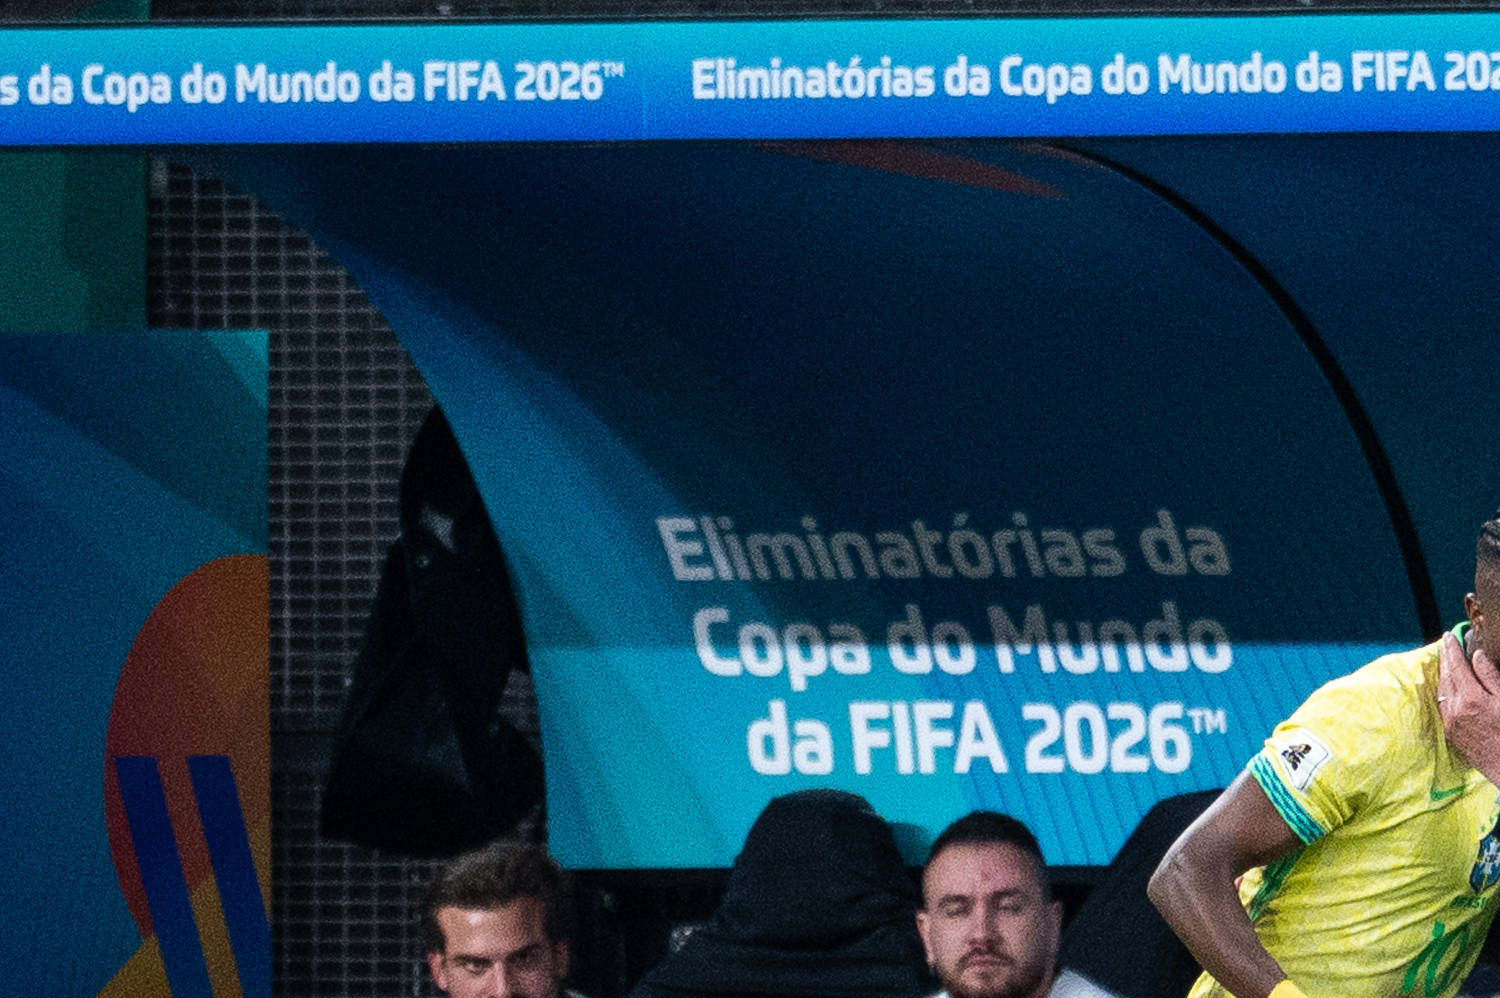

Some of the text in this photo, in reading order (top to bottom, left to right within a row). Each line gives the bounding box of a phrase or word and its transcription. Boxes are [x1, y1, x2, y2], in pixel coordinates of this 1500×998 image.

[28, 64, 73, 104] da
[82, 64, 171, 112] Copa
[181, 62, 226, 103] do
[236, 62, 360, 103] Mundo
[369, 61, 414, 102] da
[424, 61, 505, 101] FIFA
[692, 57, 934, 99] Eliminatórias
[944, 56, 990, 98] da
[1000, 55, 1092, 103] Copa
[1102, 54, 1149, 95] do
[1158, 53, 1286, 95] Mundo
[1296, 51, 1342, 93] da
[1352, 51, 1436, 92] FIFA
[657, 510, 1231, 580] Eliminatórias da
[693, 602, 1234, 690] Copa do Mundo
[747, 699, 833, 775] da
[849, 701, 1008, 774] FIFA
[1401, 919, 1470, 998] 10
